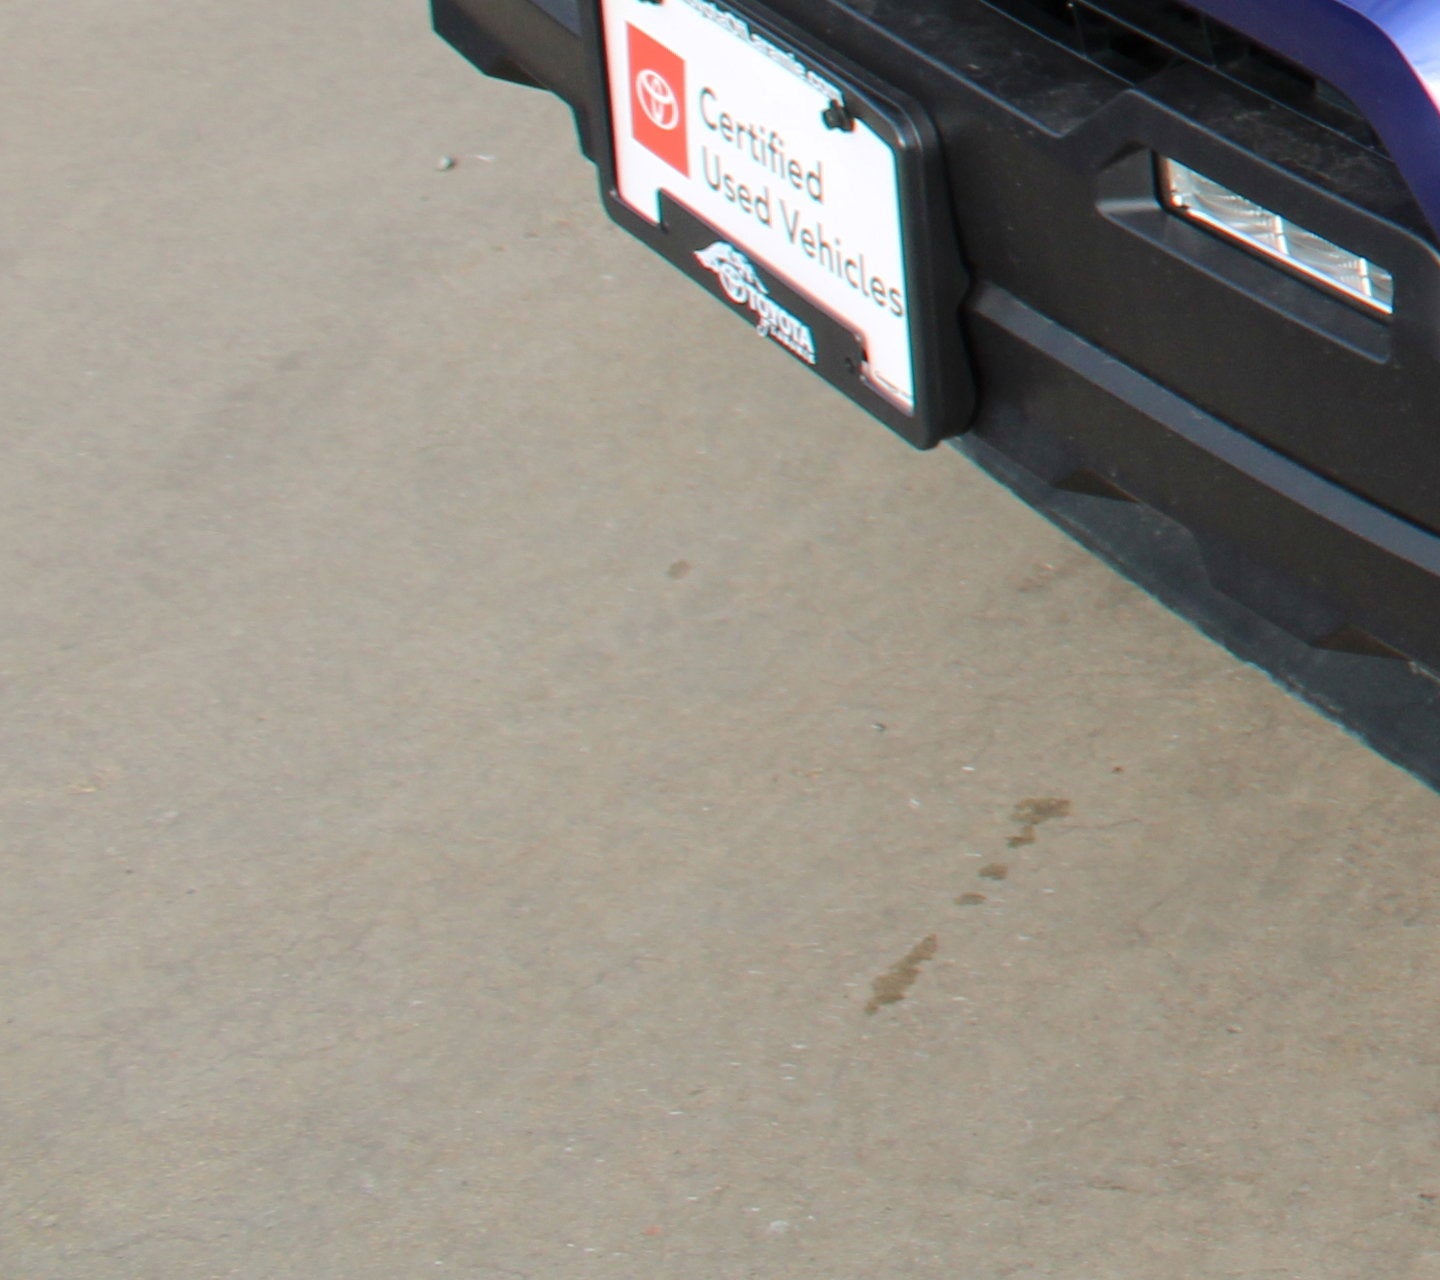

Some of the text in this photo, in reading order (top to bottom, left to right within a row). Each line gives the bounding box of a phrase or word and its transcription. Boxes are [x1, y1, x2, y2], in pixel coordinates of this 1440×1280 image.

[699, 87, 825, 206] Certified
[702, 145, 906, 318] Used Vehicles
